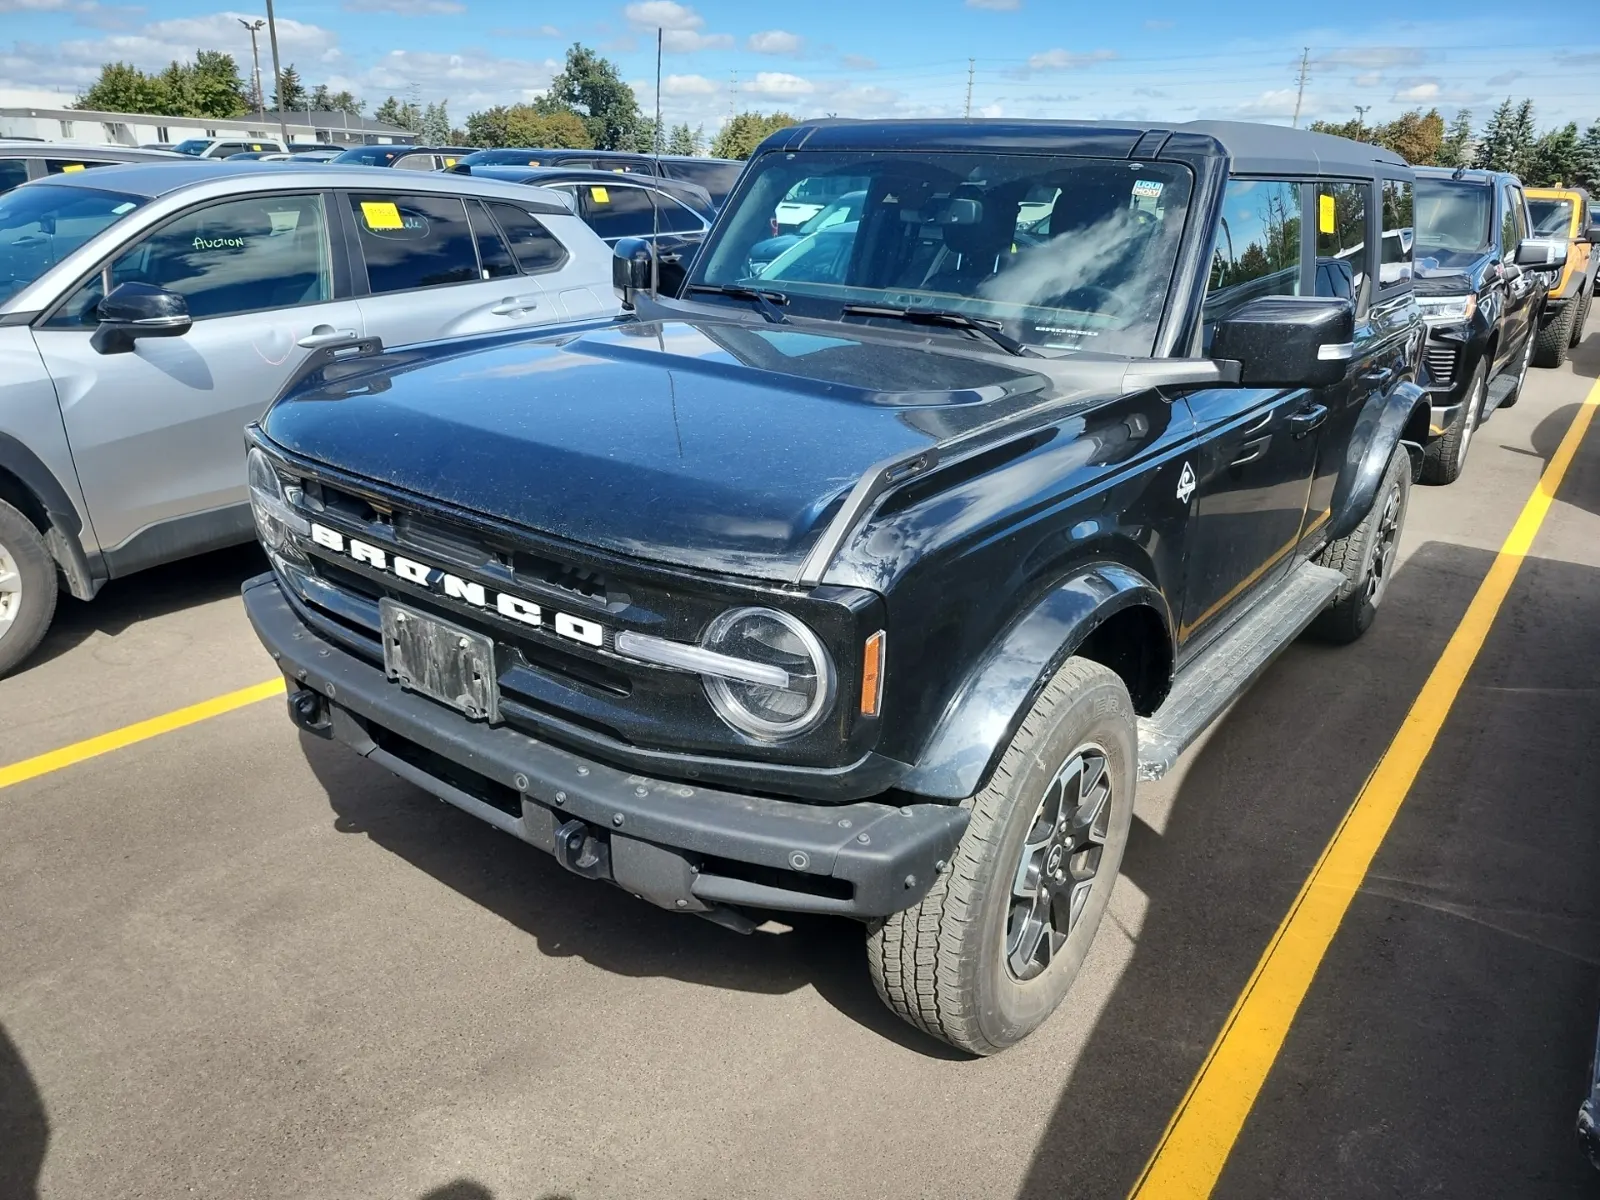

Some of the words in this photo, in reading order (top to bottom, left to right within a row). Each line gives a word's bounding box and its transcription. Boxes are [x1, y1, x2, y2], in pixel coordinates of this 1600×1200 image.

[1135, 180, 1162, 190] LIQUI
[1133, 188, 1160, 197] MOLY
[192, 236, 244, 250] AUCTION
[311, 523, 603, 647] BRONCO
